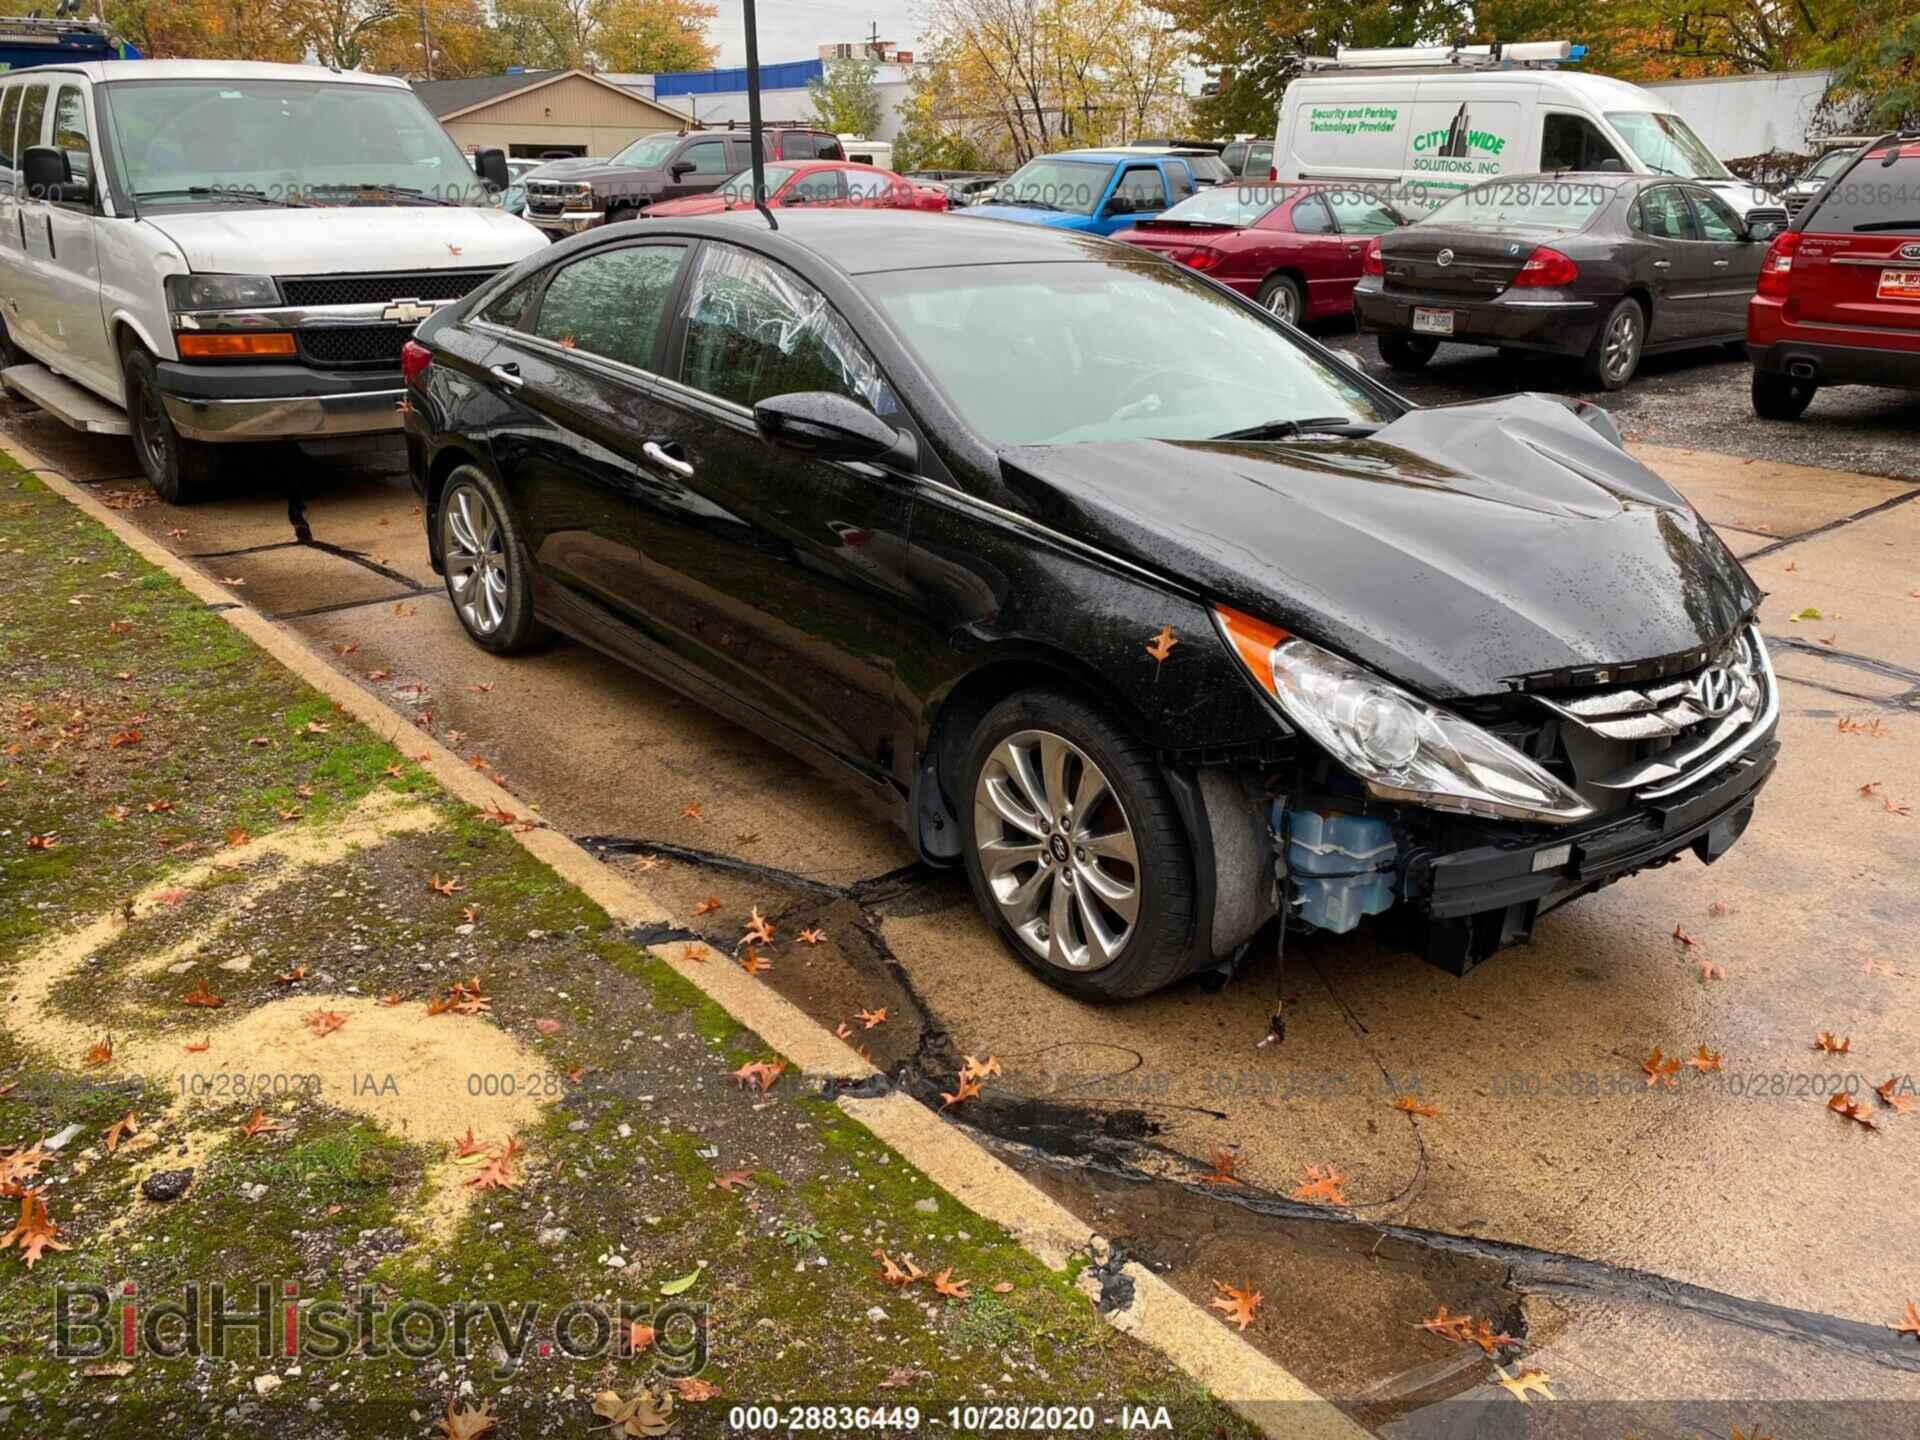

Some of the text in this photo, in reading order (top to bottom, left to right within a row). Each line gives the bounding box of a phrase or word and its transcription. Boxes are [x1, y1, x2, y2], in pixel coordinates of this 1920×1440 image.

[1311, 107, 1398, 121] Security and Parking
[1311, 121, 1394, 134] Technology Provider
[1413, 129, 1505, 155] CITY WIDE
[1413, 158, 1501, 174] SOLUTIONS, INC
